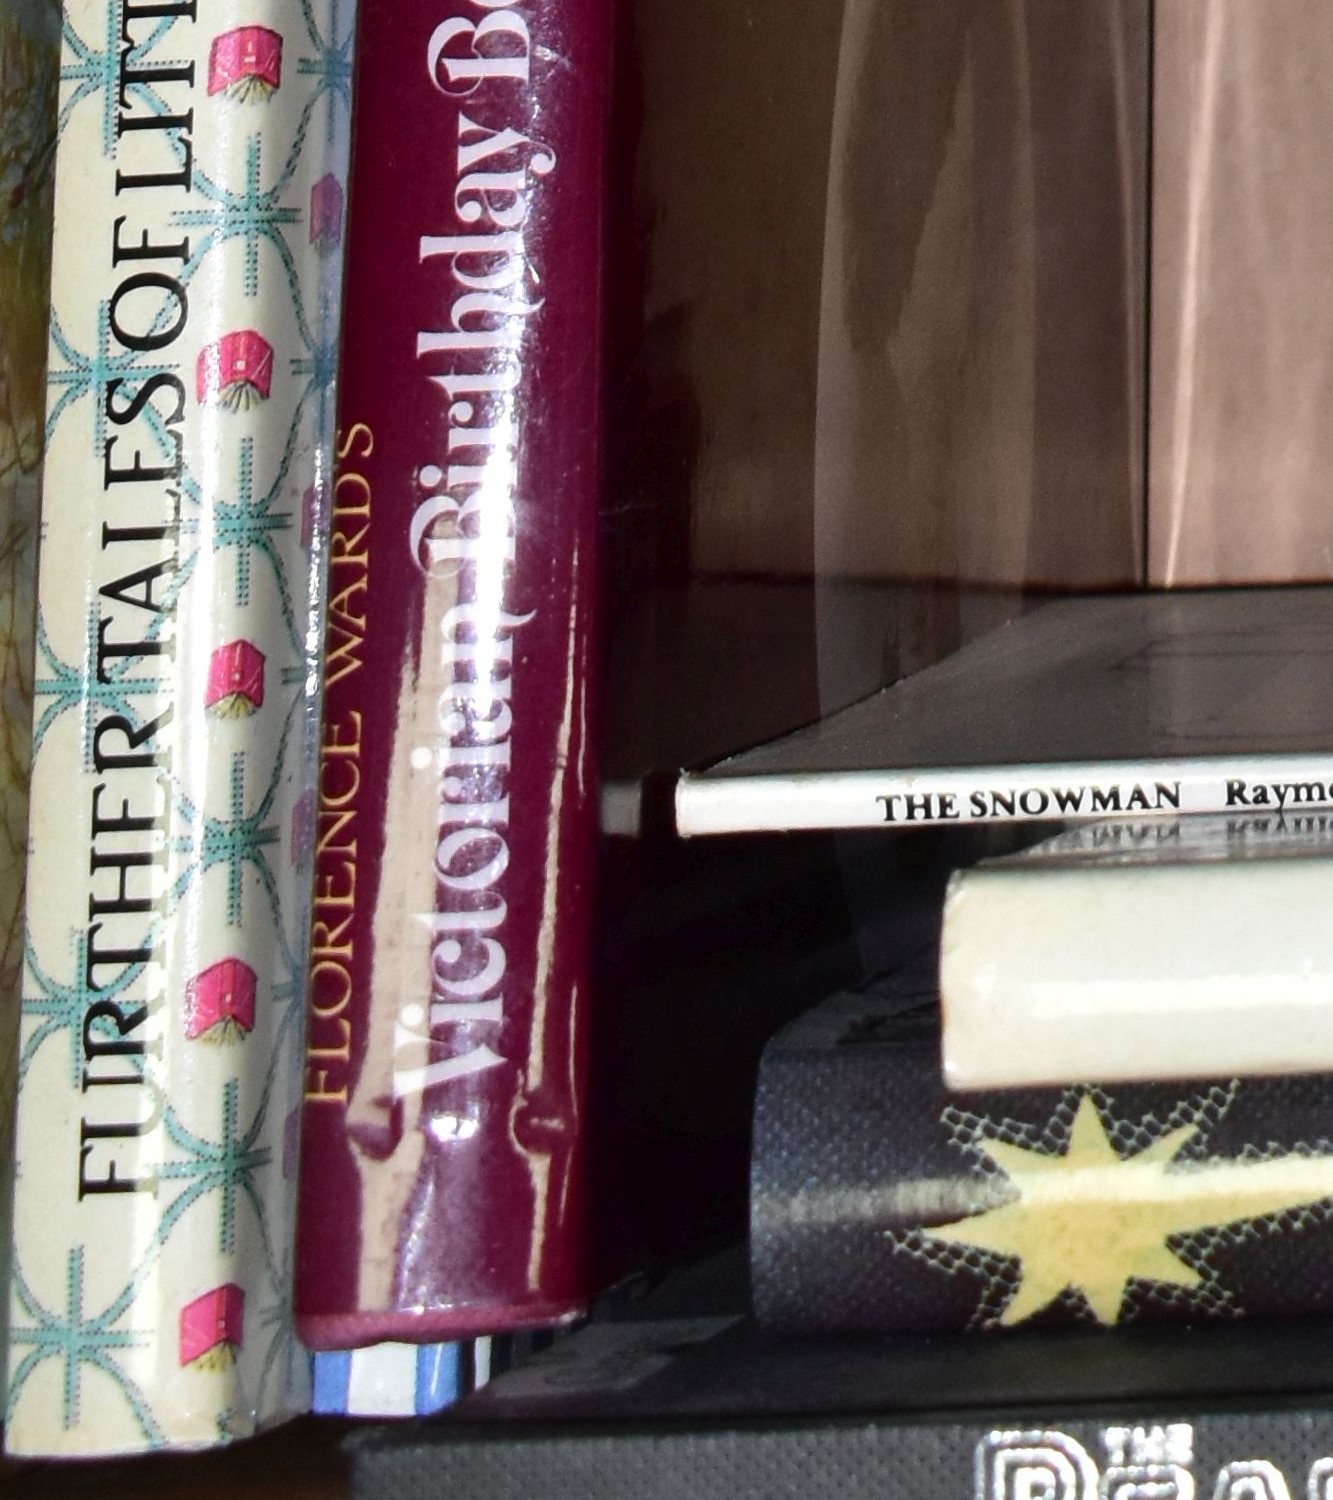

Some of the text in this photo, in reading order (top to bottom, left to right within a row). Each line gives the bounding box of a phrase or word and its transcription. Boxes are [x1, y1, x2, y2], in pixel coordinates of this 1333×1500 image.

[96, 368, 188, 688] TALES
[409, 114, 556, 590] Birthday
[76, 708, 176, 1205] FURTHER
[306, 420, 375, 1105] FLORENCE WARD'S
[876, 792, 960, 822] THE
[970, 781, 1180, 819] SNOWMAN
